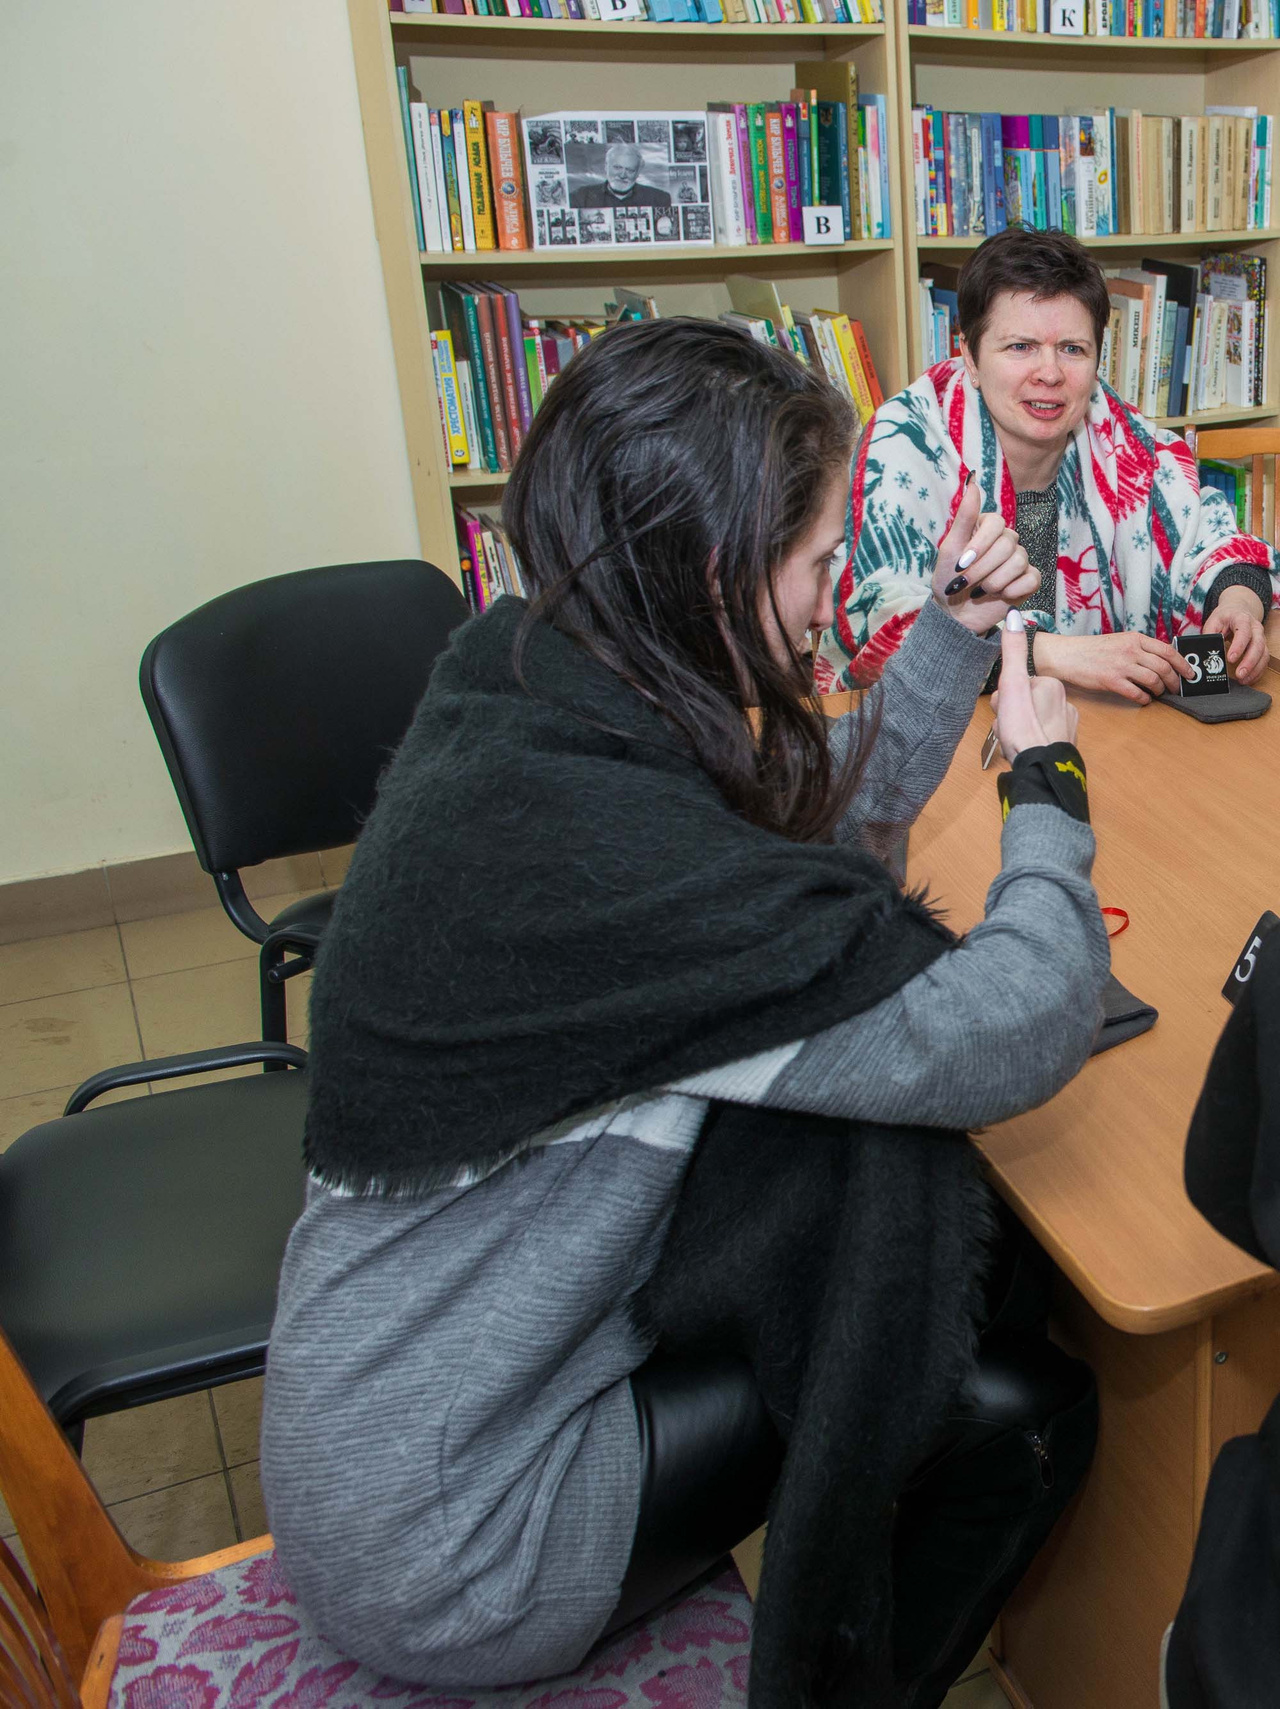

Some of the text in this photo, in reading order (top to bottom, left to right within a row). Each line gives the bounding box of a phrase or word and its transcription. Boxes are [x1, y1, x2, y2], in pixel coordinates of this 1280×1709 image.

[1060, 8, 1076, 27] К
[496, 119, 513, 178] КИР БУЛЫЧЕВ
[770, 119, 783, 174] КИР БУЛЫЧЕВ
[509, 201, 519, 233] АЛИСА
[655, 207, 678, 215] КИР
[1087, 180, 1095, 230] КРАПИВИН
[815, 216, 831, 234] В
[485, 332, 495, 361] КОРОЛЕЙ
[491, 363, 500, 402] ПОДЗЕМНЫХ
[445, 377, 461, 435] ХРЕСТОМАТИЯ
[1184, 653, 1203, 684] 8
[1234, 935, 1263, 983] 5
